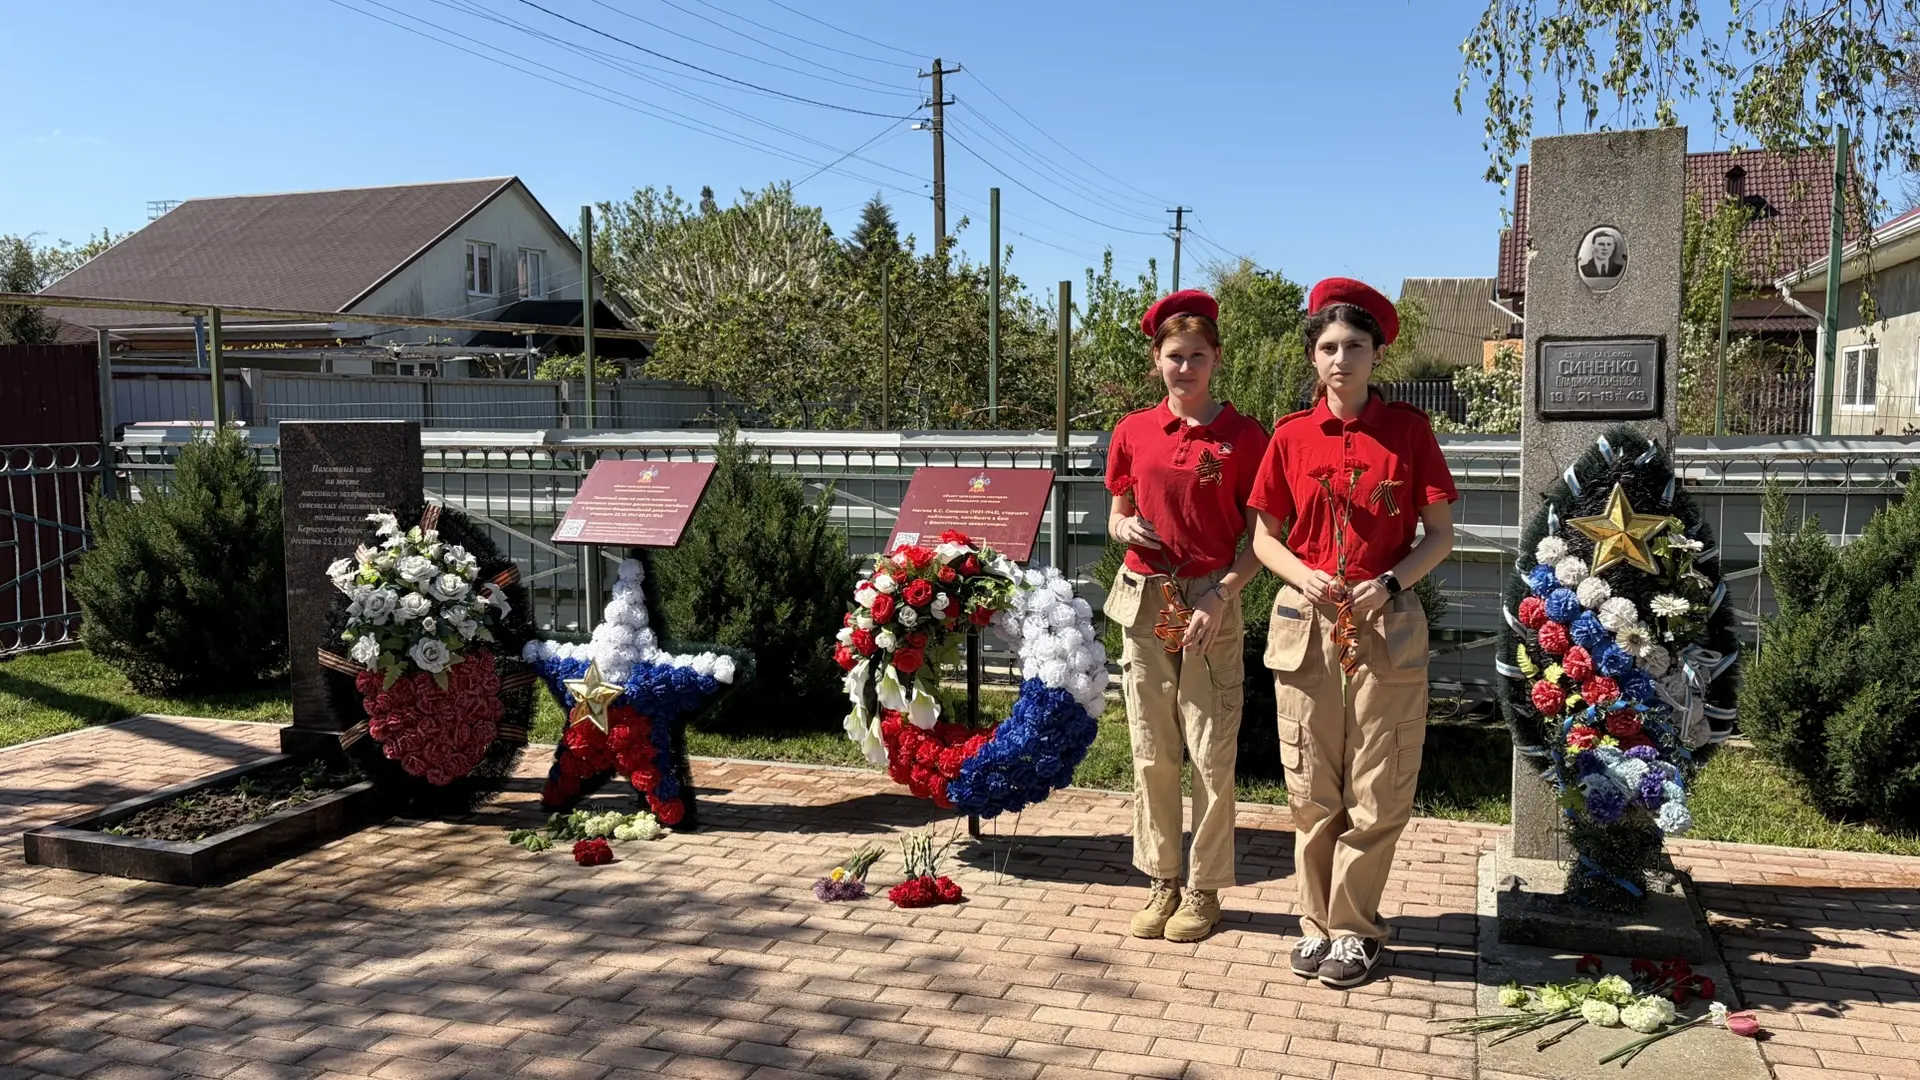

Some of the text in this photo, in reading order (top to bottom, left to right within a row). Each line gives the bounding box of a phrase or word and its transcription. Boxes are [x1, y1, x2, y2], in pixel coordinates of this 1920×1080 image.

[1558, 360, 1640, 374] СИНЕНКО
[312, 464, 354, 473] Памятный
[340, 490, 386, 498] захоронения
[314, 513, 350, 522] погибших
[298, 524, 364, 534] Керченско-Феодос
[290, 537, 321, 545] десанта
